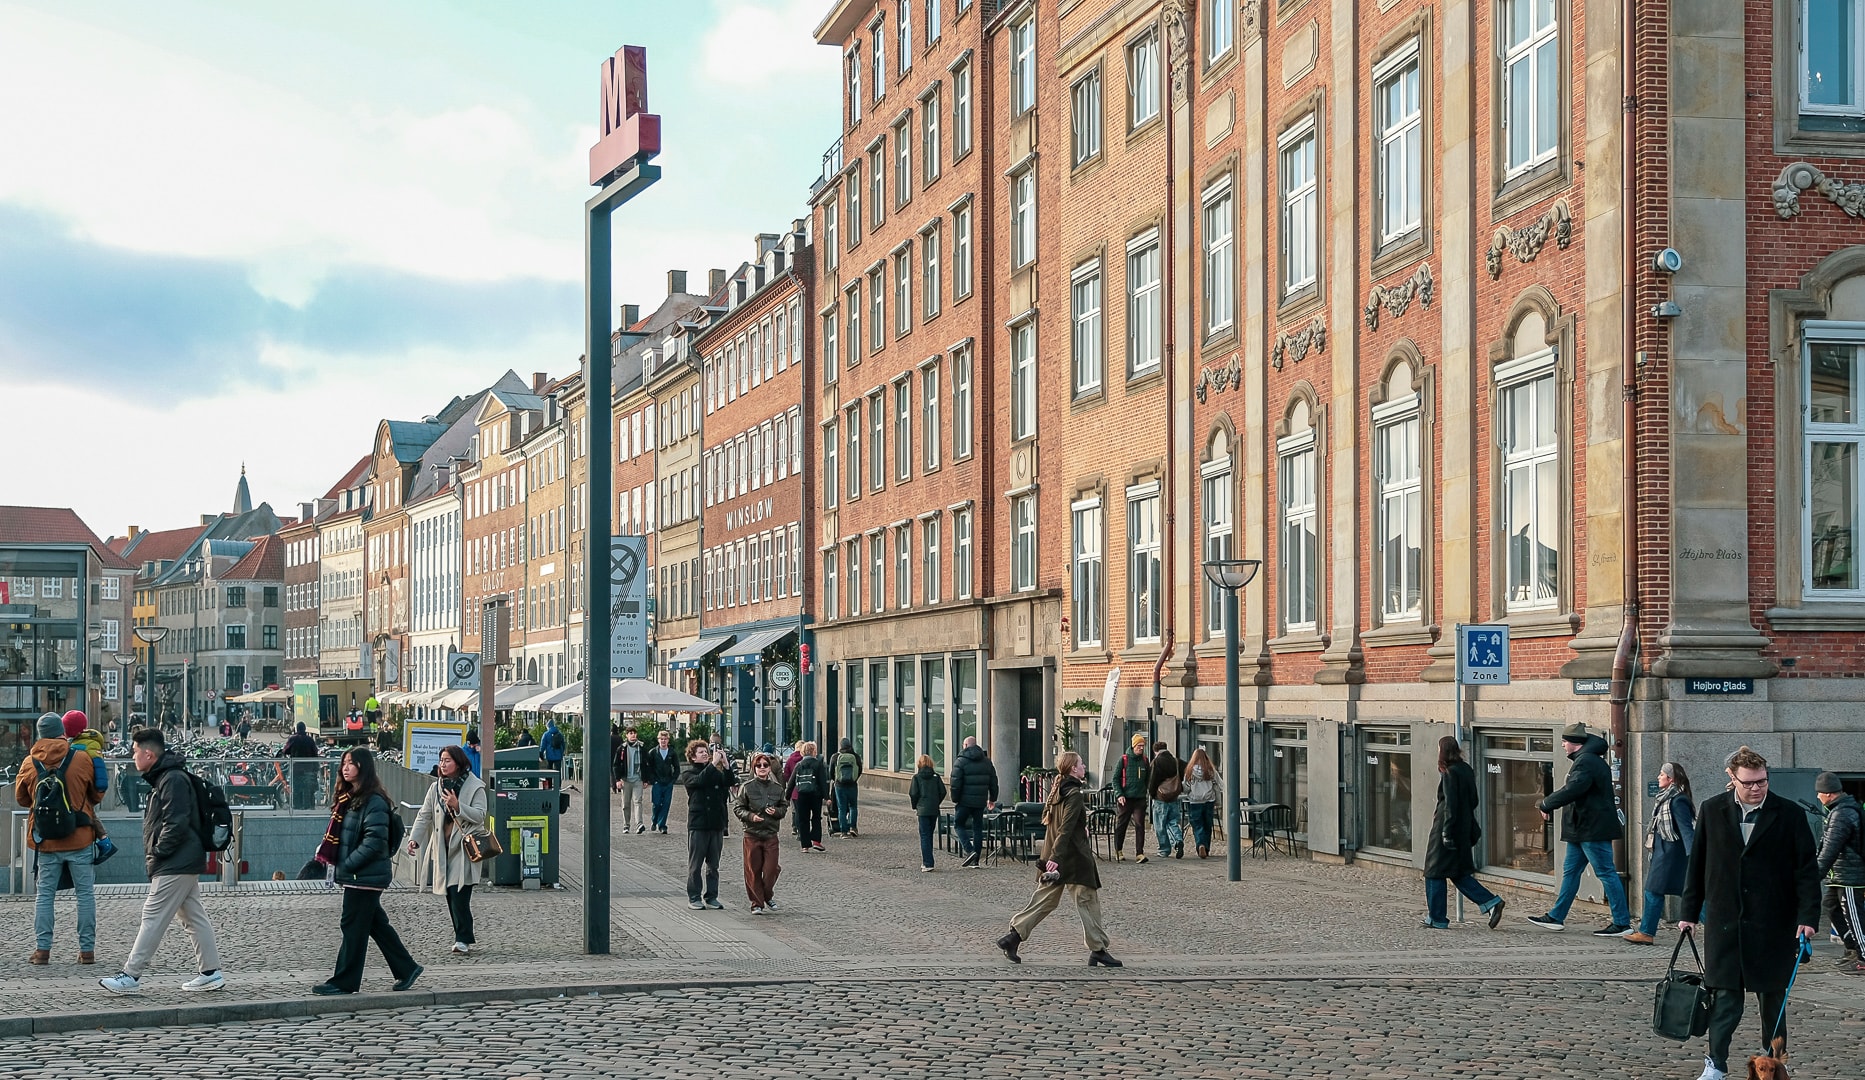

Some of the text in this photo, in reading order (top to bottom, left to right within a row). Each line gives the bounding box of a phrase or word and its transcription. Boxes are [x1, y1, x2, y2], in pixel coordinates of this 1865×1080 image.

[726, 496, 773, 532] WINSLØW
[1715, 548, 1742, 560] Plads
[457, 663, 471, 672] 30
[1472, 672, 1498, 680] Zone
[1576, 682, 1609, 691] Gammel Strand
[1693, 681, 1746, 692] Højbro Plads
[1366, 755, 1378, 764] Mesh
[1488, 763, 1502, 774] Mesh
